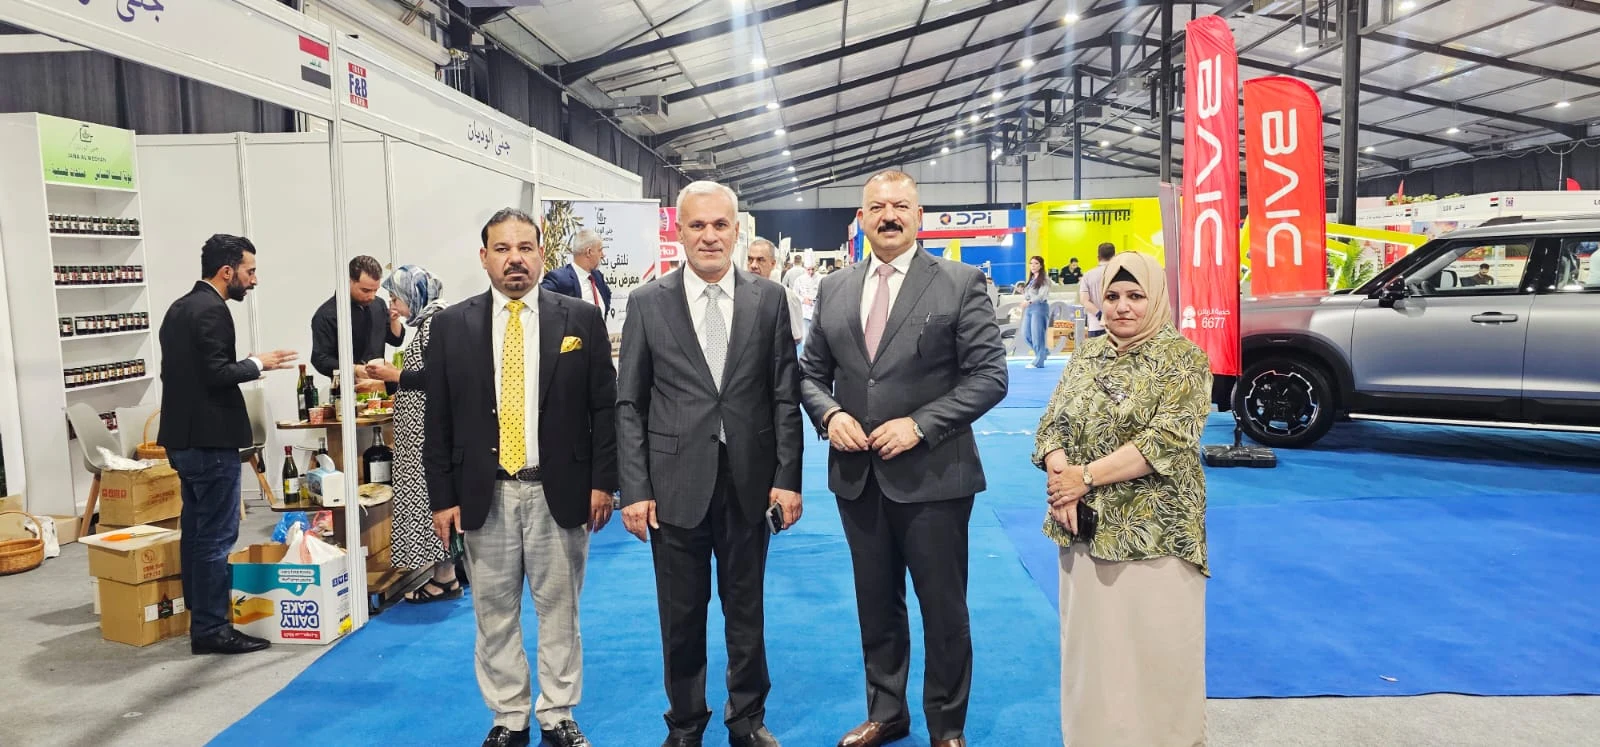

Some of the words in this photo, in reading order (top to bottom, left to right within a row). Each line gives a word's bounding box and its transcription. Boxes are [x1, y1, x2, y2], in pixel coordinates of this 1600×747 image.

[348, 73, 368, 98] F&B
[467, 119, 494, 150] الوديان
[494, 134, 511, 156] جنى
[1193, 54, 1223, 268] BAIC
[1261, 108, 1303, 268] BAIC
[618, 273, 640, 288] معرض
[1201, 317, 1226, 329] 6677
[281, 601, 318, 614] CAKE
[281, 614, 319, 628] DAILY
